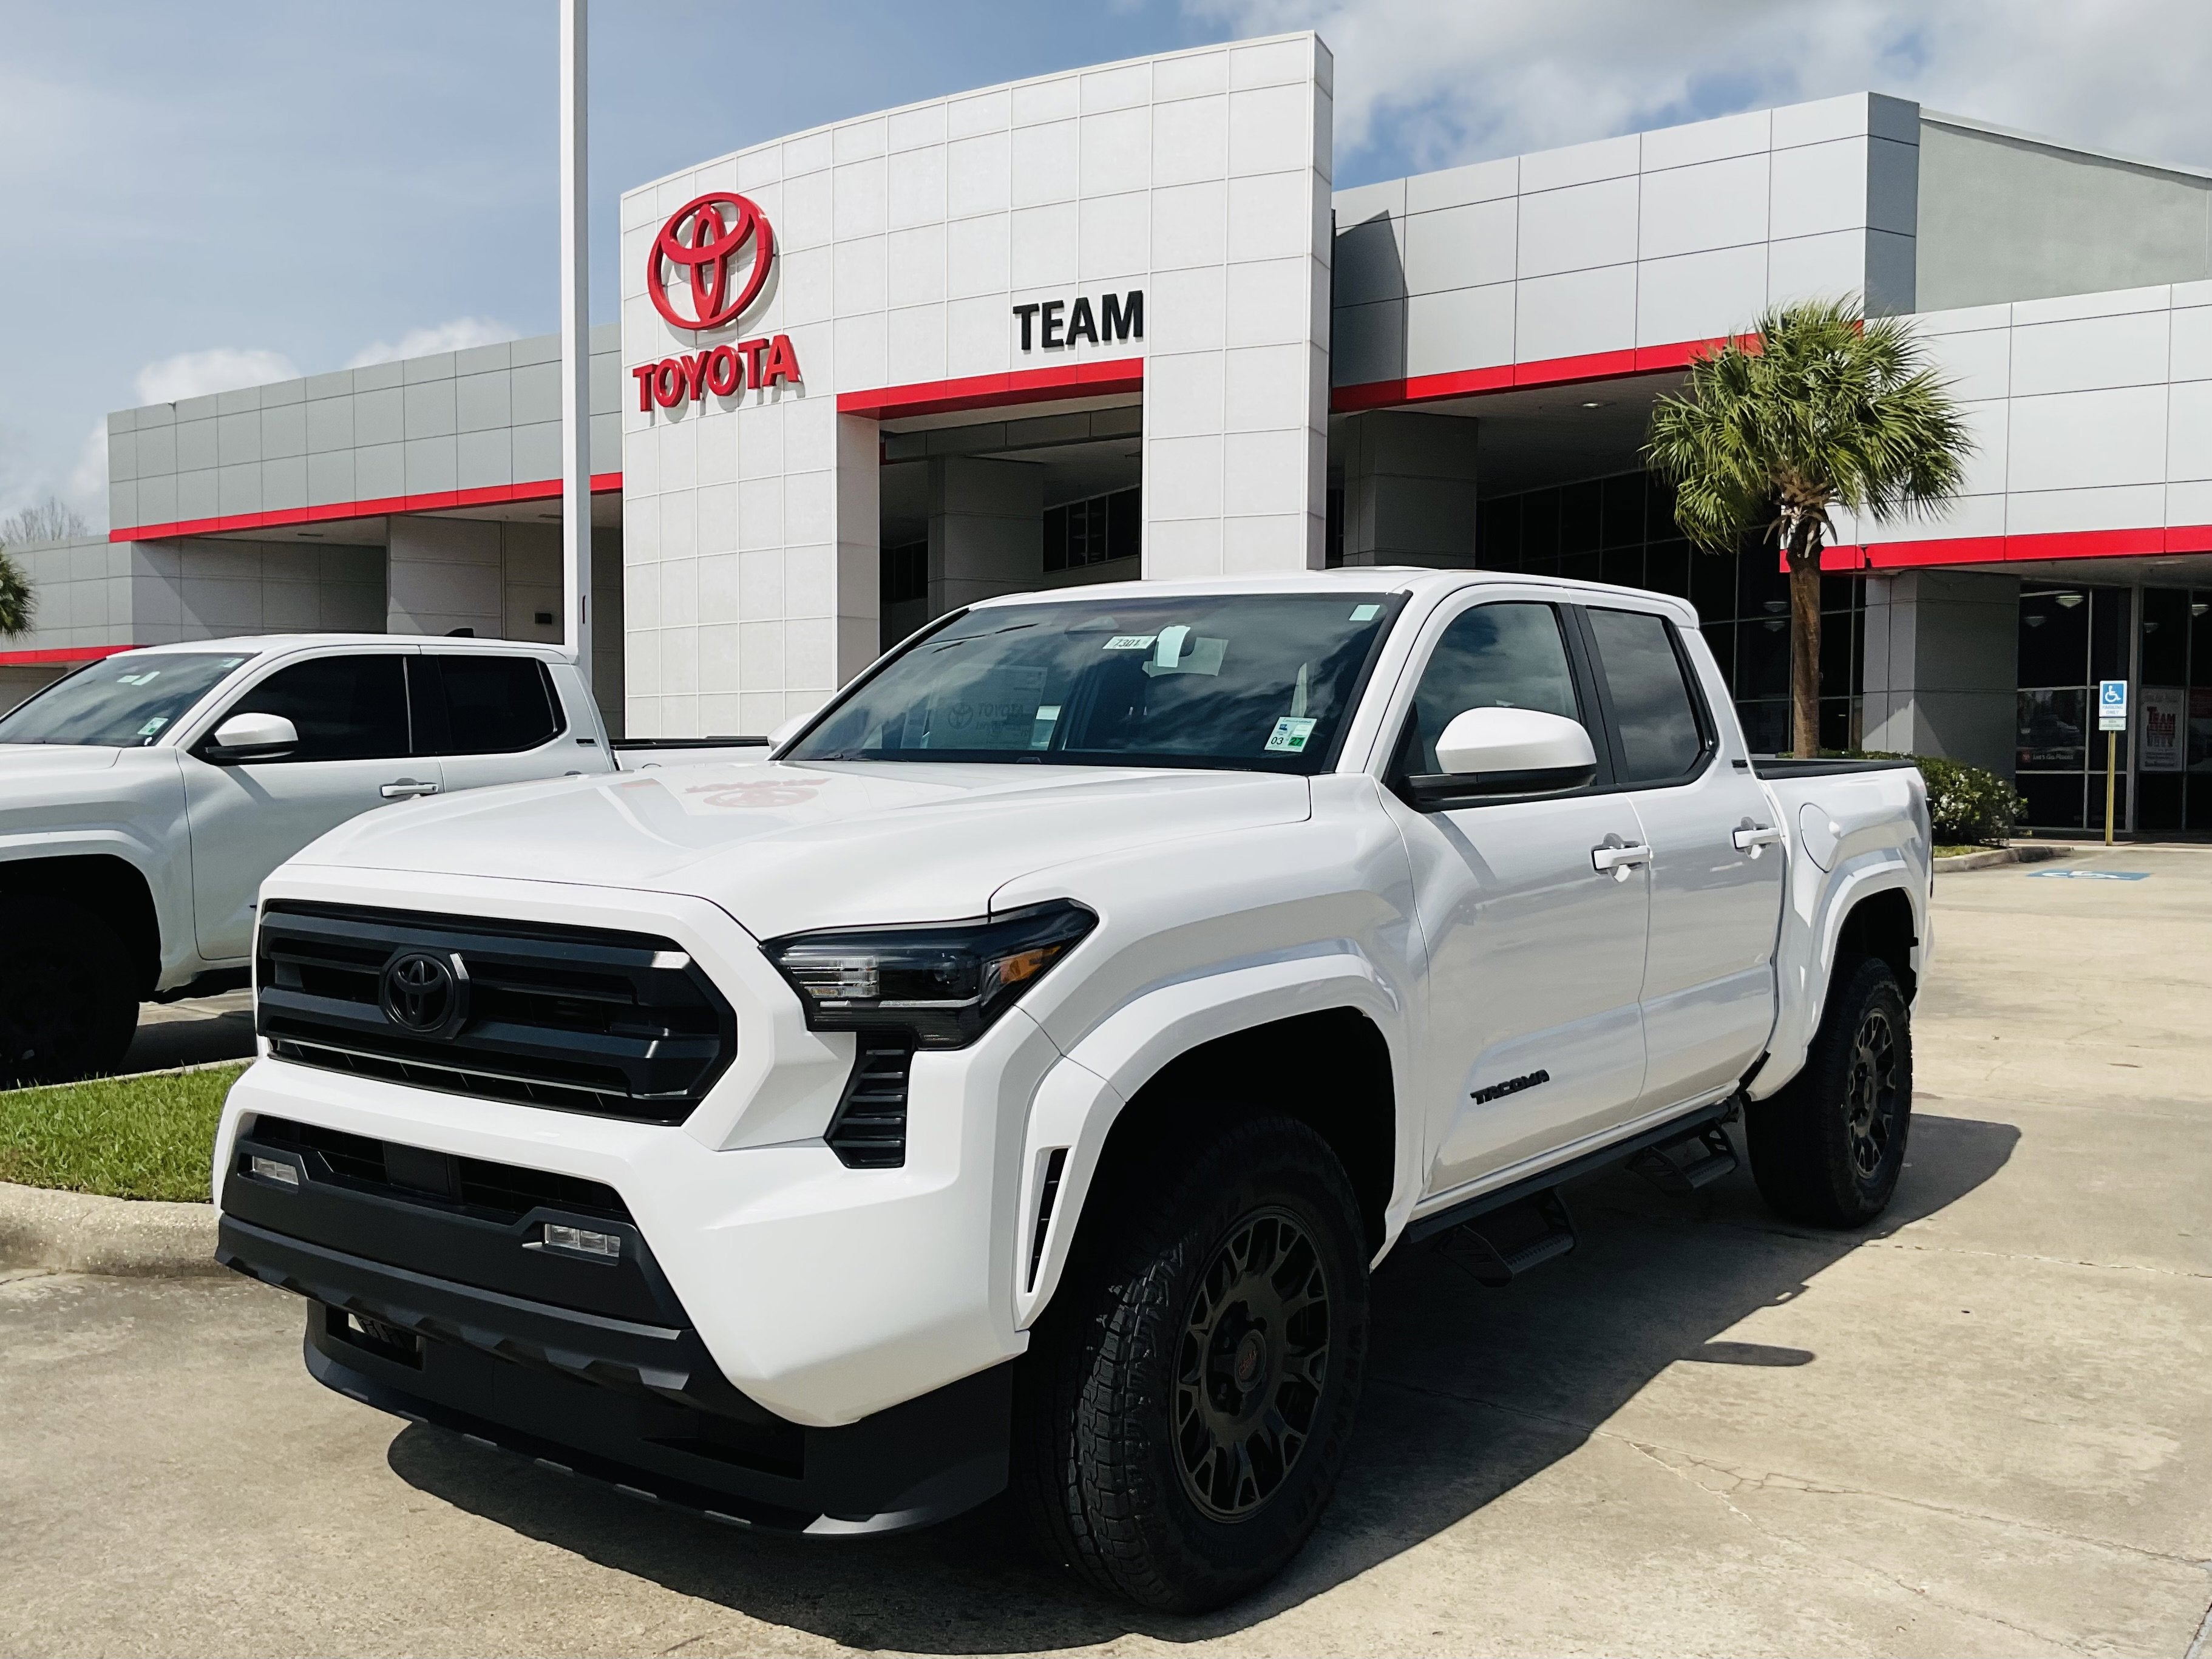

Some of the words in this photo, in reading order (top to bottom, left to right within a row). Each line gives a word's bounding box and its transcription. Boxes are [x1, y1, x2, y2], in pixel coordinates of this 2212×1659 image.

[1013, 290, 1144, 350] TEAM
[632, 334, 801, 413] TOYOTA
[1271, 736, 1284, 745] 03
[1290, 736, 1305, 746] 27
[1470, 1069, 1550, 1105] TACOMA
